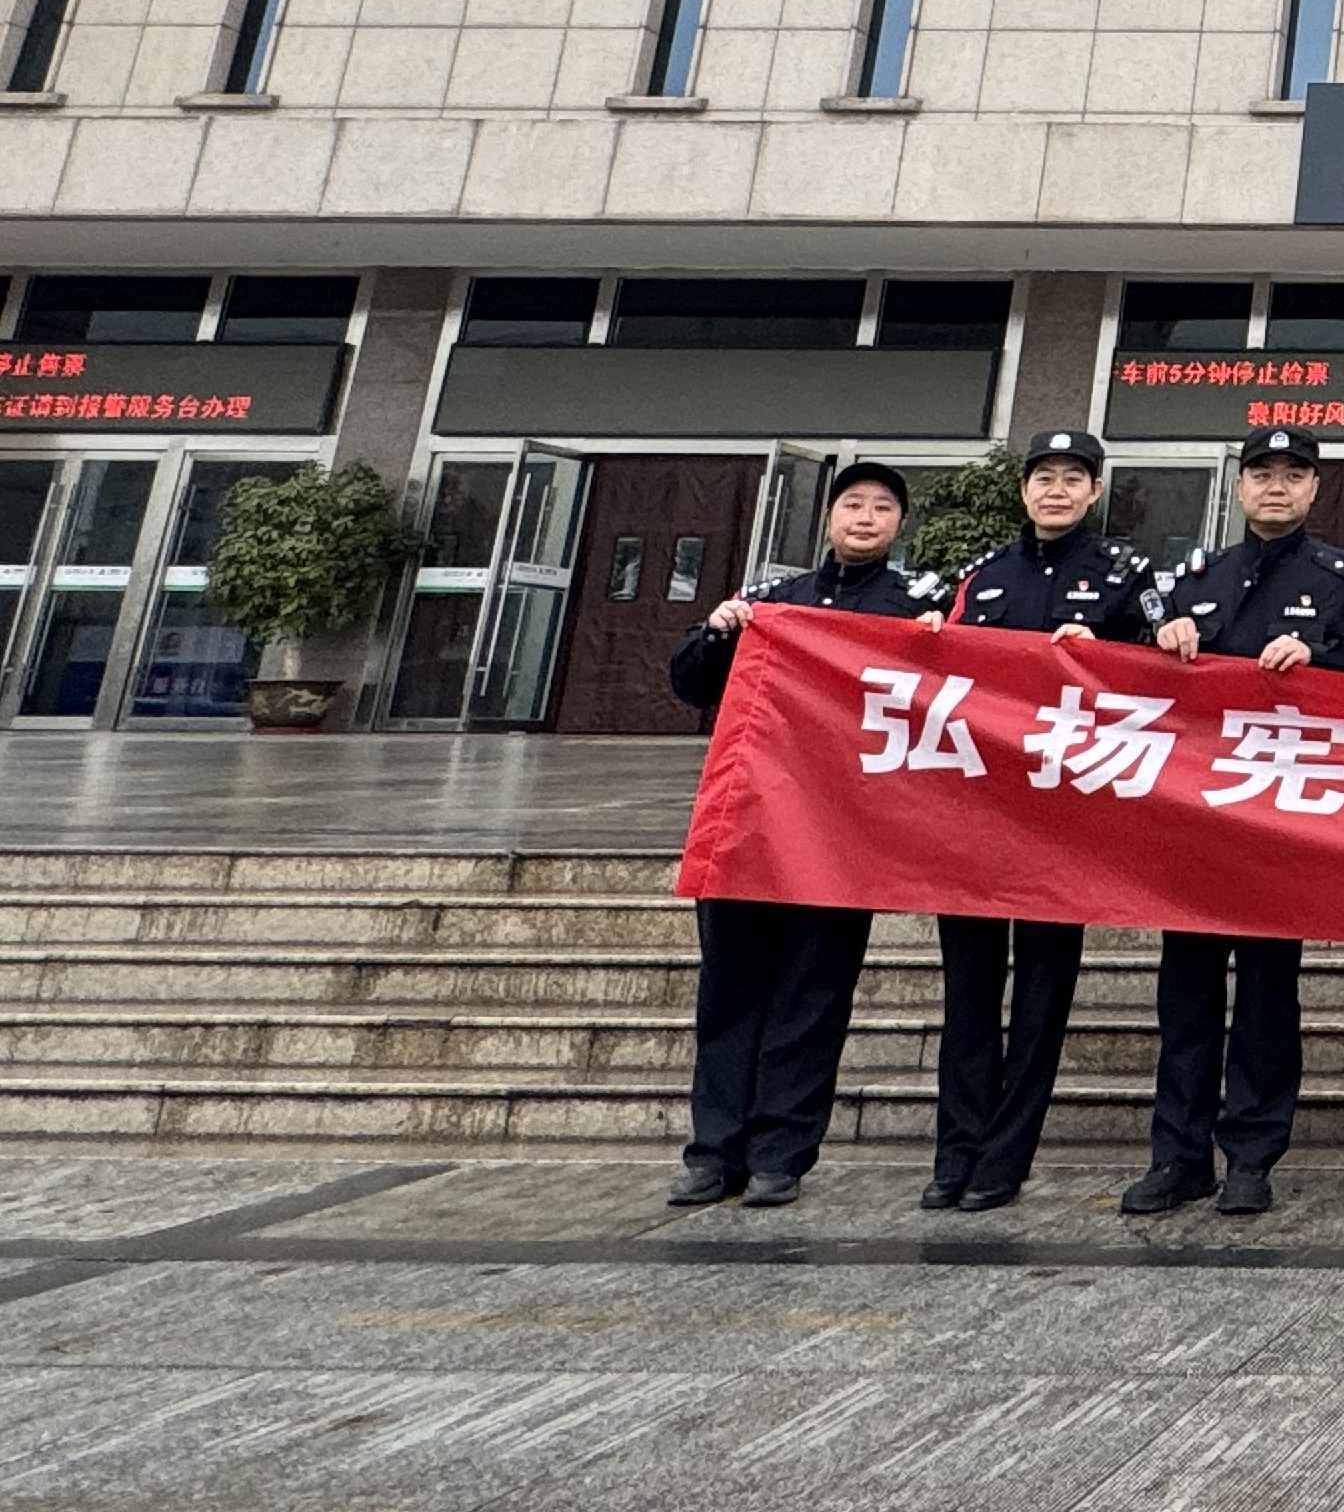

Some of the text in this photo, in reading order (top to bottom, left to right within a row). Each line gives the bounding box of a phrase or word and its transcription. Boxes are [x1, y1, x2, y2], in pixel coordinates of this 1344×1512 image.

[1114, 360, 1329, 386] 车前5分钟停止检票
[0, 392, 251, 420] 证请到报警服务台办理
